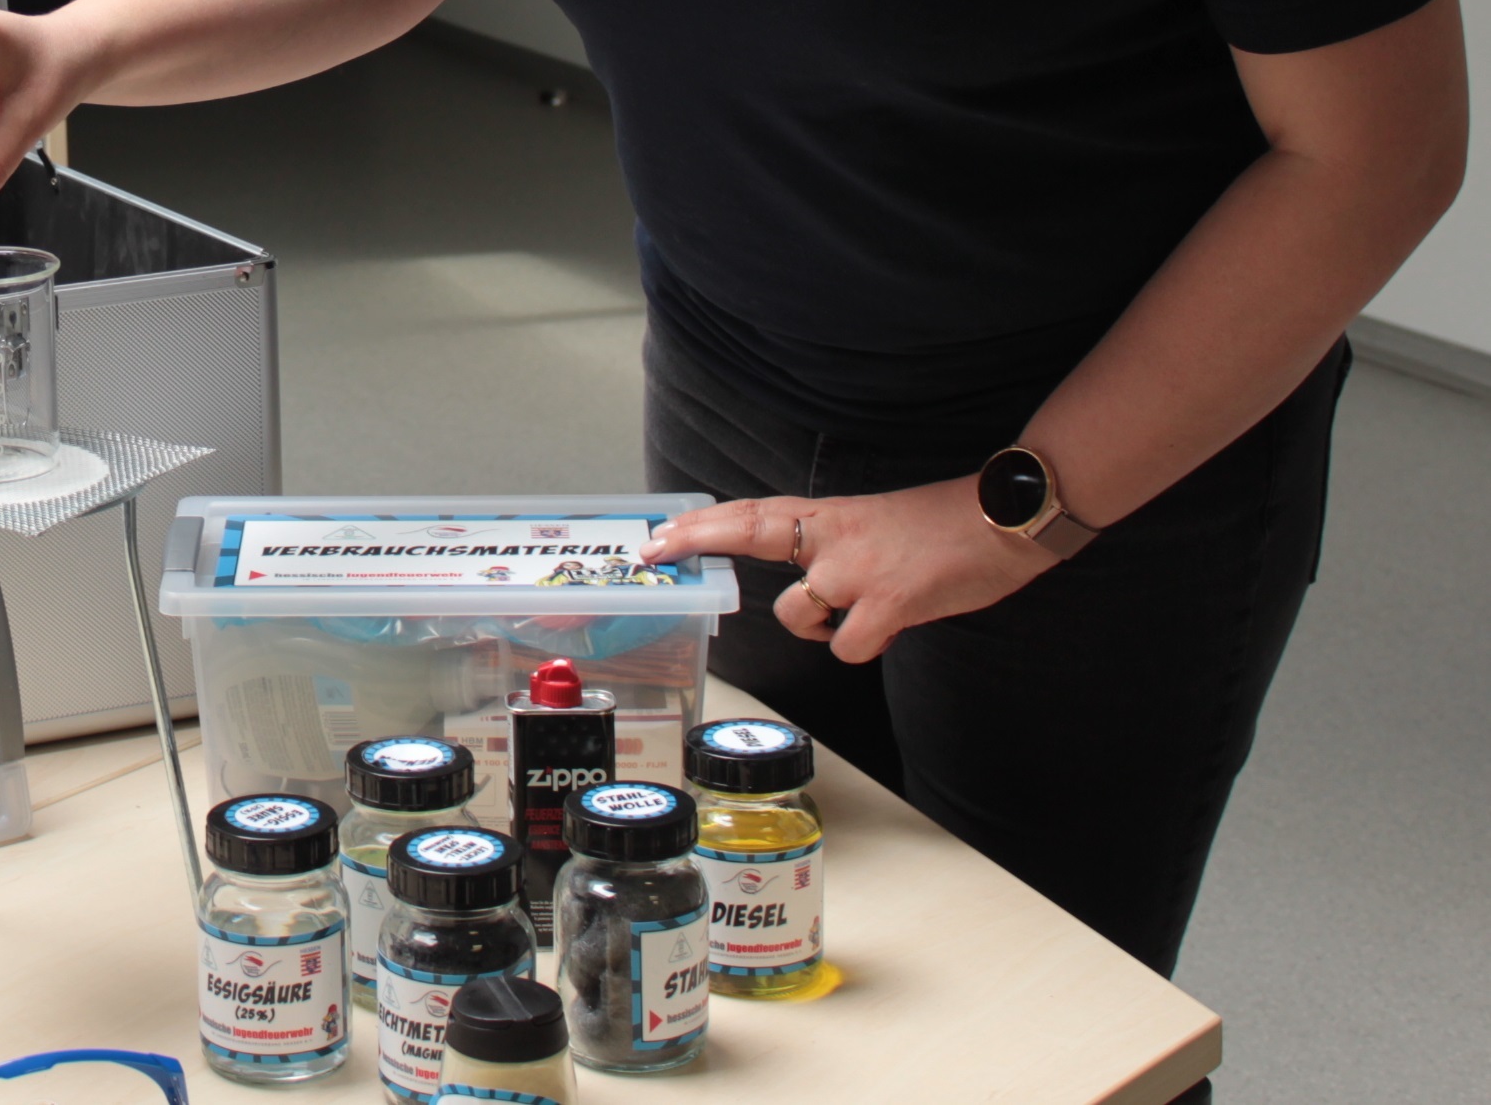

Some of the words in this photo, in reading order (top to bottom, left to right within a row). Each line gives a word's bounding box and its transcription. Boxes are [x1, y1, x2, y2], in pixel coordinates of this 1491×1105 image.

[260, 543, 630, 557] VERBRAUCHSMATERIAL
[346, 571, 464, 580] jugendfeuerwehr
[461, 736, 484, 744] HBM
[596, 791, 657, 805] STAHL-
[608, 797, 665, 813] WOLLE
[711, 901, 788, 929] DIESEL
[726, 938, 803, 954] jugendfeuerwehr
[664, 957, 709, 1000] STAH
[207, 972, 313, 1006] ESSIGSÄURE
[235, 1005, 275, 1023] (25%)
[378, 1002, 447, 1045] EICHTMET
[232, 1026, 314, 1040] jugendfeuerwehr
